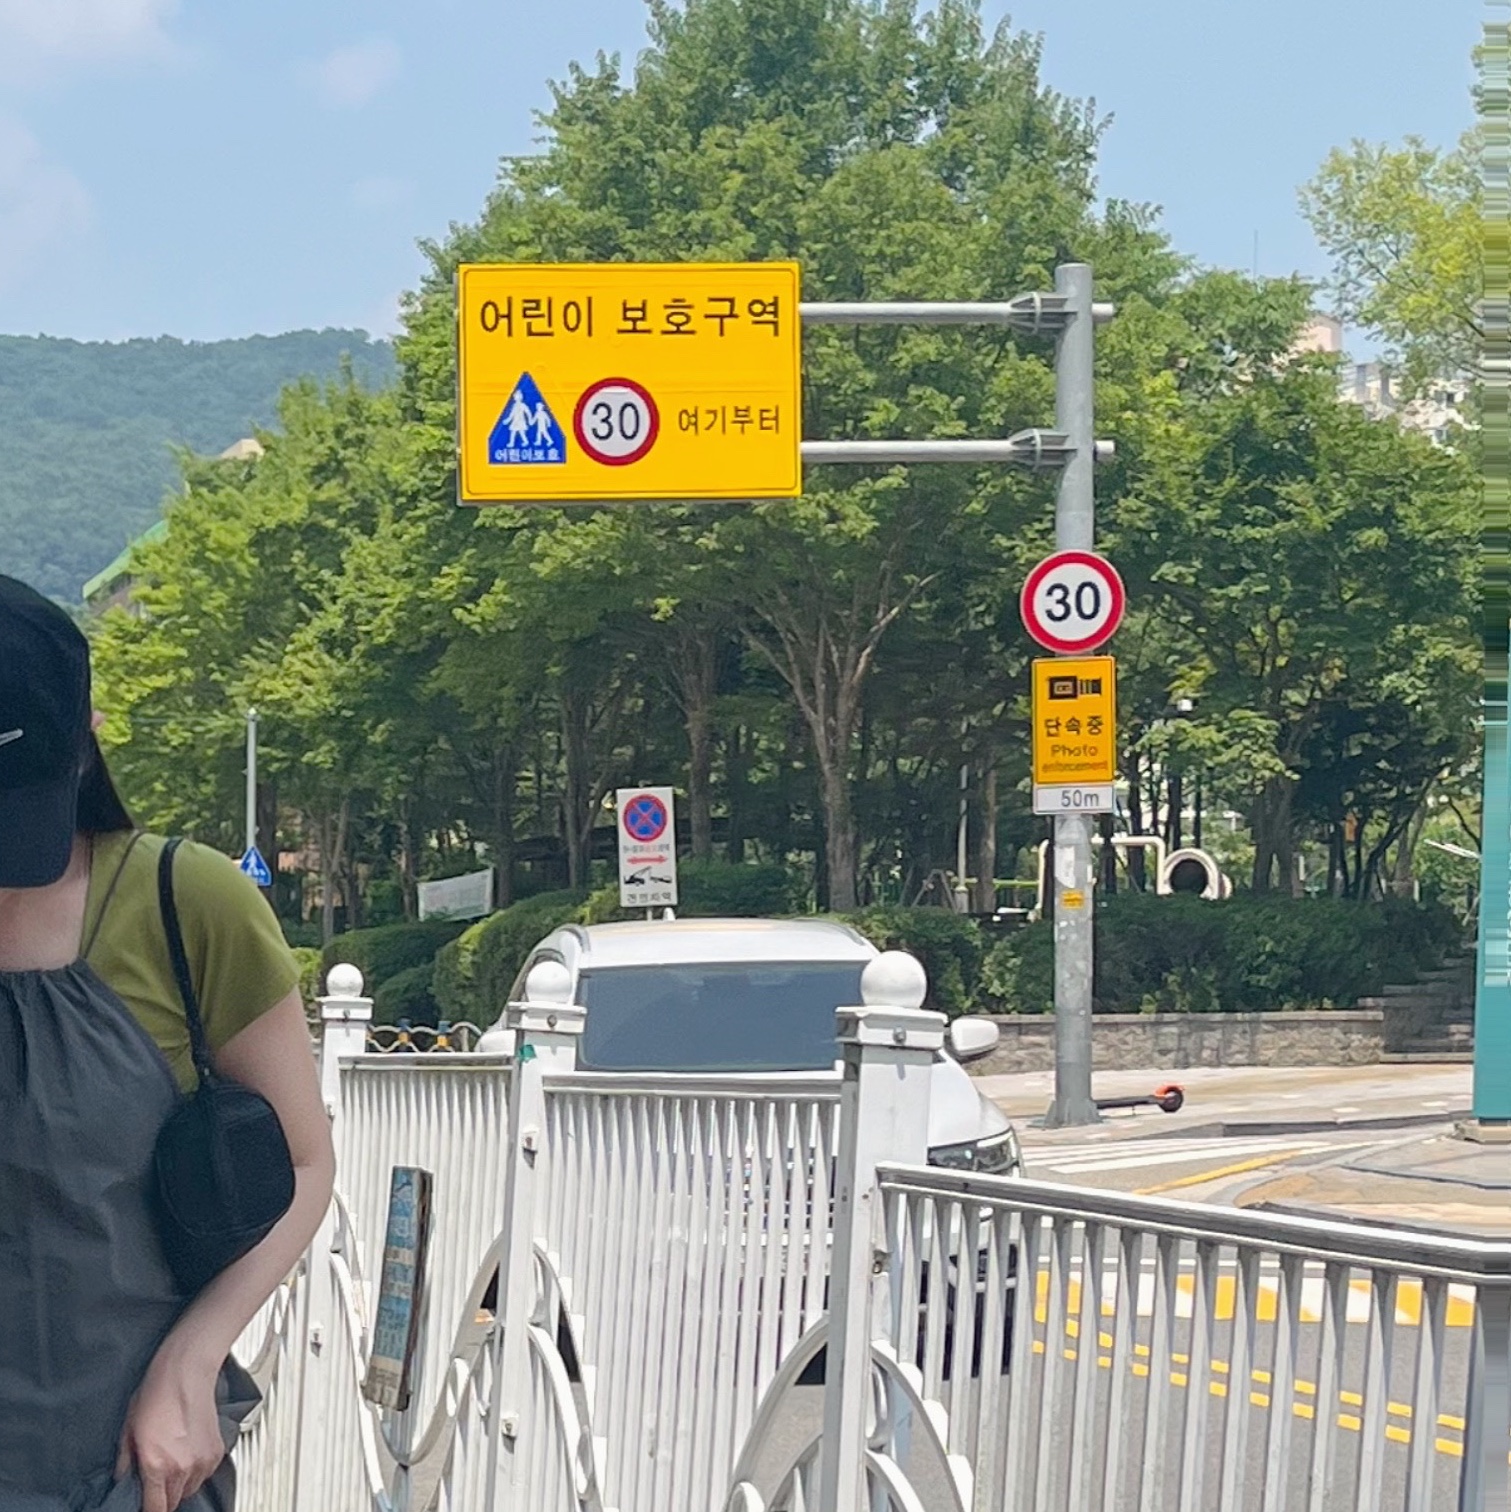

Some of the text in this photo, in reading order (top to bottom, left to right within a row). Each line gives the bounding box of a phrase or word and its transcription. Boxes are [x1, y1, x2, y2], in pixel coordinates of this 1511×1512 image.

[480, 295, 779, 337] 어린이 보호구역
[591, 402, 640, 441] 30
[677, 405, 780, 436] 여기부터
[494, 447, 560, 462] 어린이보호
[1044, 581, 1100, 622] 30
[1050, 744, 1098, 757] Photo
[1061, 789, 1099, 807] 50m
